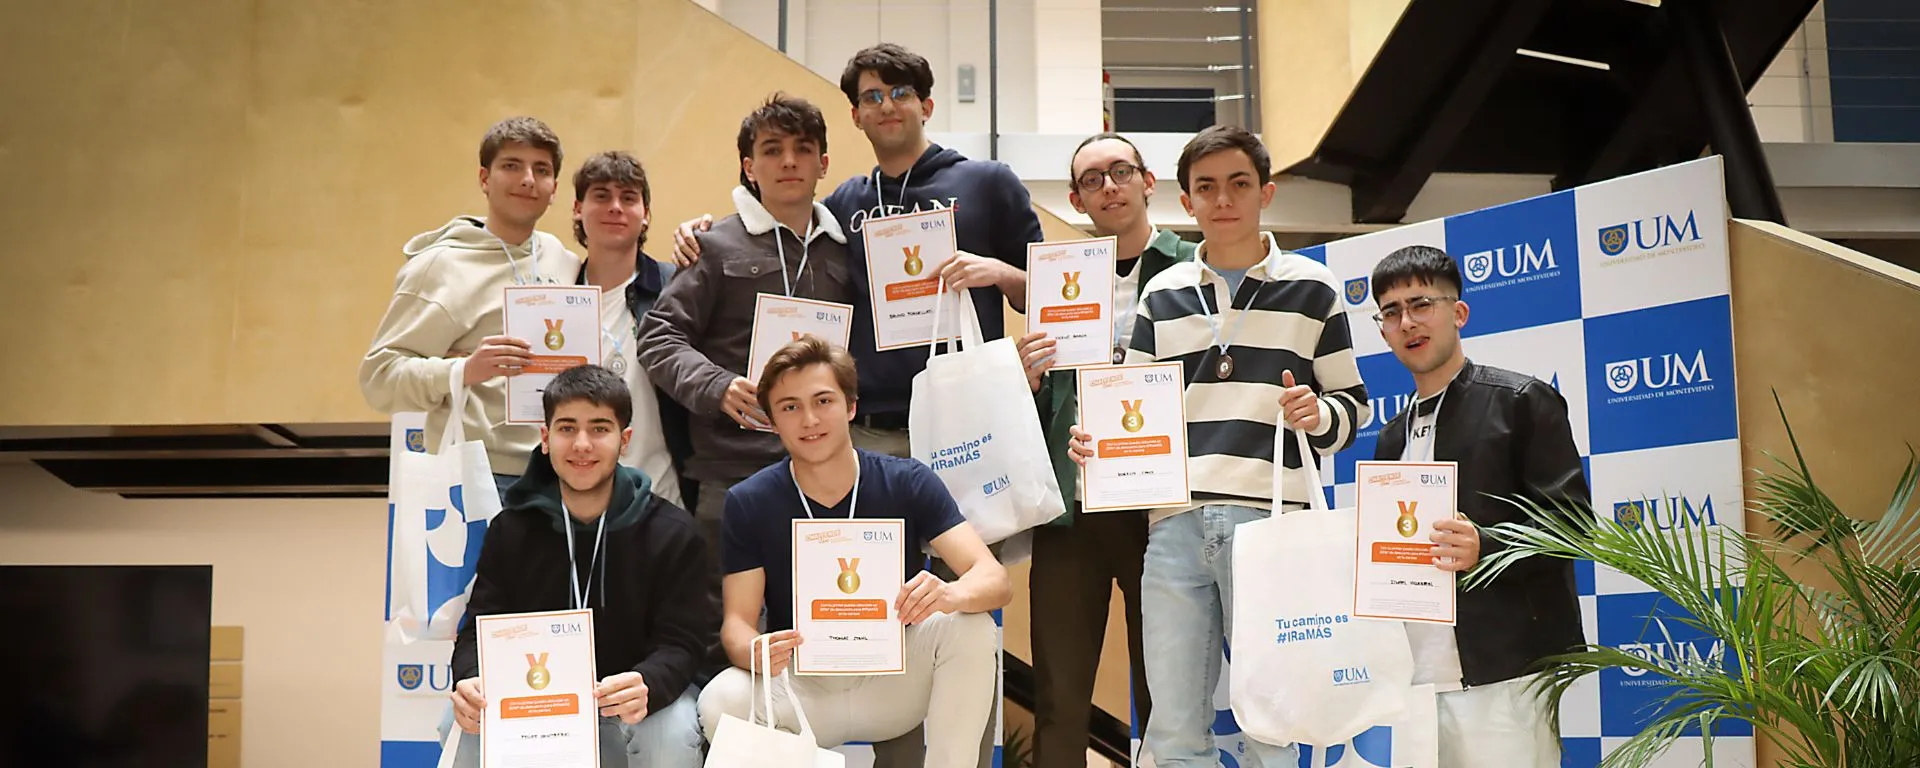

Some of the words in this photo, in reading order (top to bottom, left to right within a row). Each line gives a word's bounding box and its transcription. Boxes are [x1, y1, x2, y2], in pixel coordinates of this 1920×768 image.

[1632, 208, 1704, 250] UM
[1494, 238, 1559, 277] UM
[549, 335, 559, 346] 2
[1639, 348, 1713, 389] UM
[1607, 392, 1655, 405] UNIVERSIDAD
[1655, 391, 1665, 399] DE
[1666, 384, 1715, 397] MONTEVIDEO
[1127, 416, 1138, 428] 3
[939, 439, 981, 457] camino
[982, 432, 993, 444] es
[993, 475, 1010, 491] UM
[1429, 474, 1447, 485] UM
[1648, 494, 1720, 531] UM
[1402, 519, 1412, 532] 3
[873, 531, 893, 542] UM
[561, 622, 582, 634] UM
[1275, 618, 1290, 630] Tu
[1292, 614, 1332, 627] camino
[1335, 614, 1349, 623] es
[1277, 626, 1332, 644] #IRaMÁS
[532, 672, 544, 684] 2
[1345, 666, 1369, 682] UM
